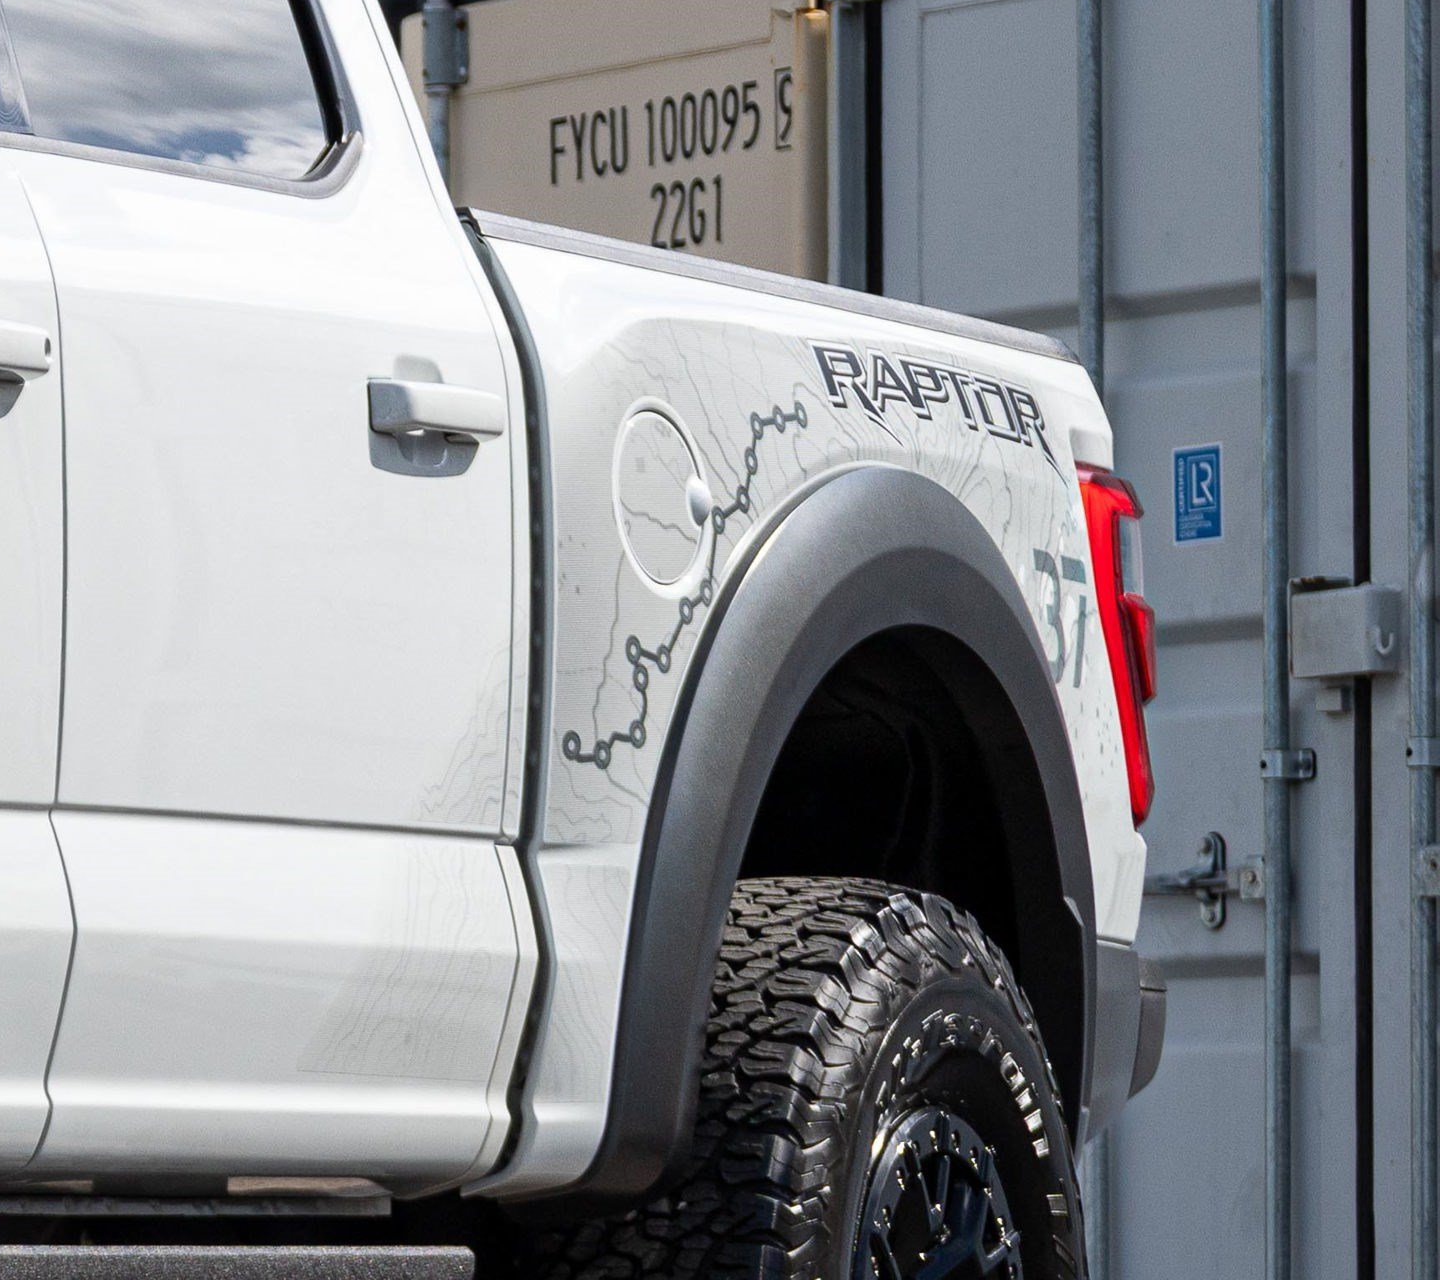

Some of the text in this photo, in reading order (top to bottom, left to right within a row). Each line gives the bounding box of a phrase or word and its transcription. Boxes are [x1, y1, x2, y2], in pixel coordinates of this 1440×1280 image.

[549, 104, 629, 185] FYCU
[644, 79, 761, 166] 100095
[650, 174, 723, 248] 22G1
[806, 338, 1072, 489] RAPTOR
[1192, 462, 1213, 504] LR
[1032, 546, 1088, 690] 37
